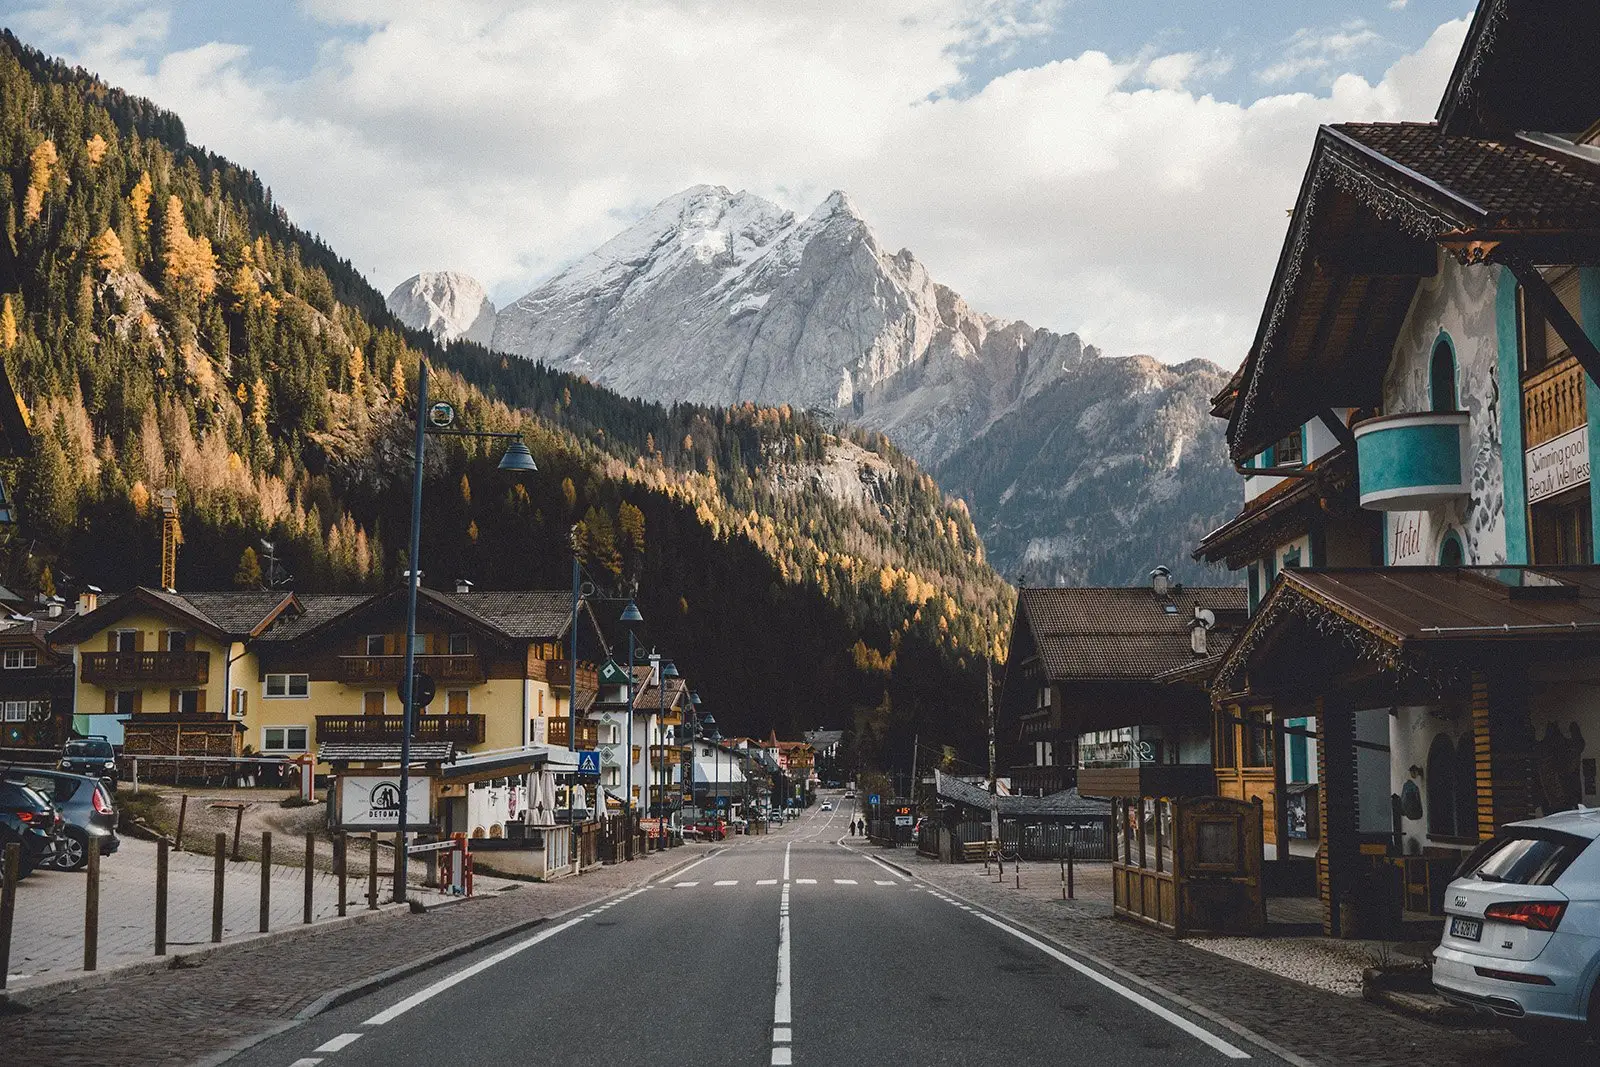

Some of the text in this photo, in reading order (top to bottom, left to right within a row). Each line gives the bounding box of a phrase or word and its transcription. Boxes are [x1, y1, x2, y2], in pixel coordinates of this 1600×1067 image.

[1565, 430, 1585, 466] pool
[1391, 511, 1422, 565] Hotel
[369, 810, 399, 818] DETOMA
